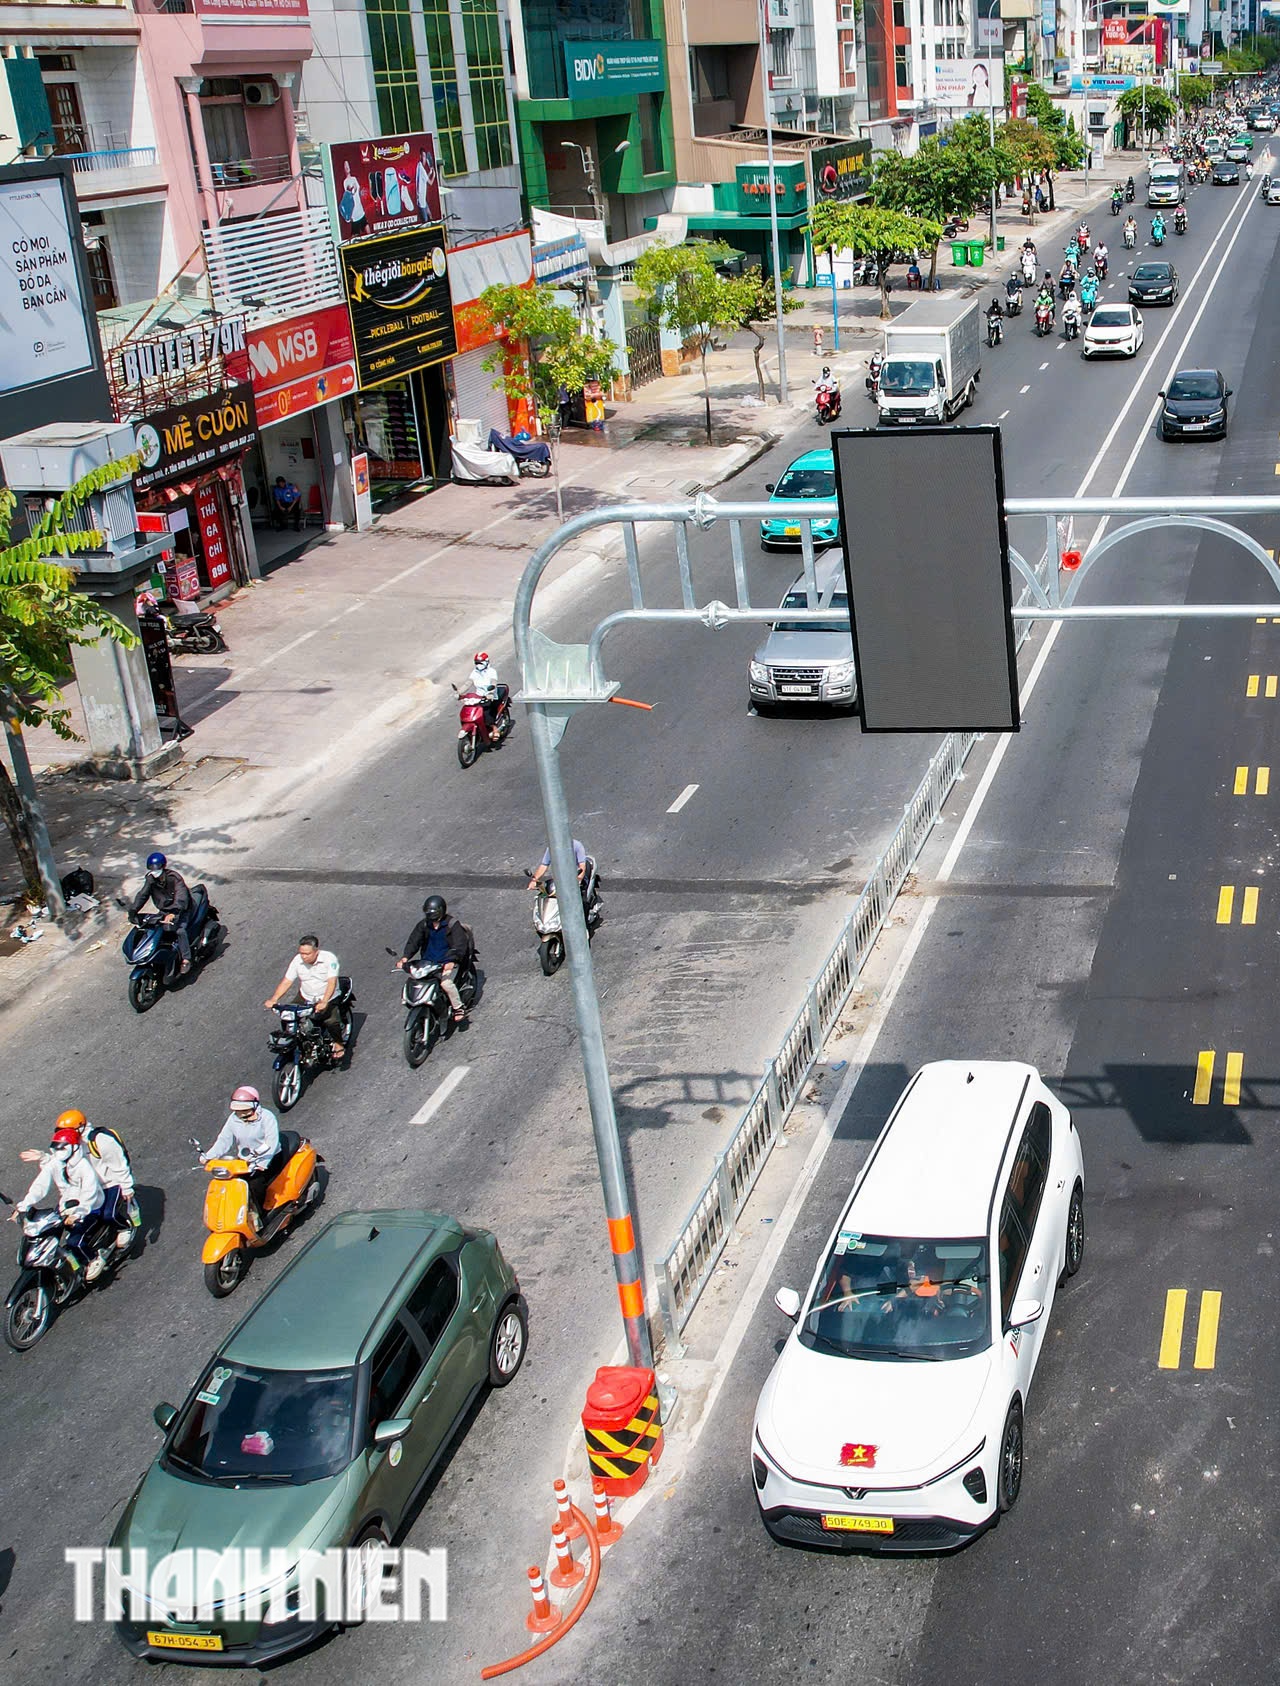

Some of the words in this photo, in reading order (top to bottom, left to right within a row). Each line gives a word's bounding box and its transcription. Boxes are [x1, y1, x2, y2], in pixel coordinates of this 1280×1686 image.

[574, 58, 597, 81] BIDV
[12, 236, 28, 254] CÓ
[30, 236, 50, 252] MỌI
[15, 255, 37, 273] SẢN
[39, 247, 68, 268] PHẨM
[19, 271, 35, 292] ĐỒ
[37, 273, 52, 288] DA
[23, 294, 45, 311] BẠN
[46, 285, 68, 305] CẦN
[123, 331, 202, 385] BUFFET
[207, 319, 246, 359] 79K
[277, 328, 318, 368] MSB
[164, 415, 194, 455] MÊ
